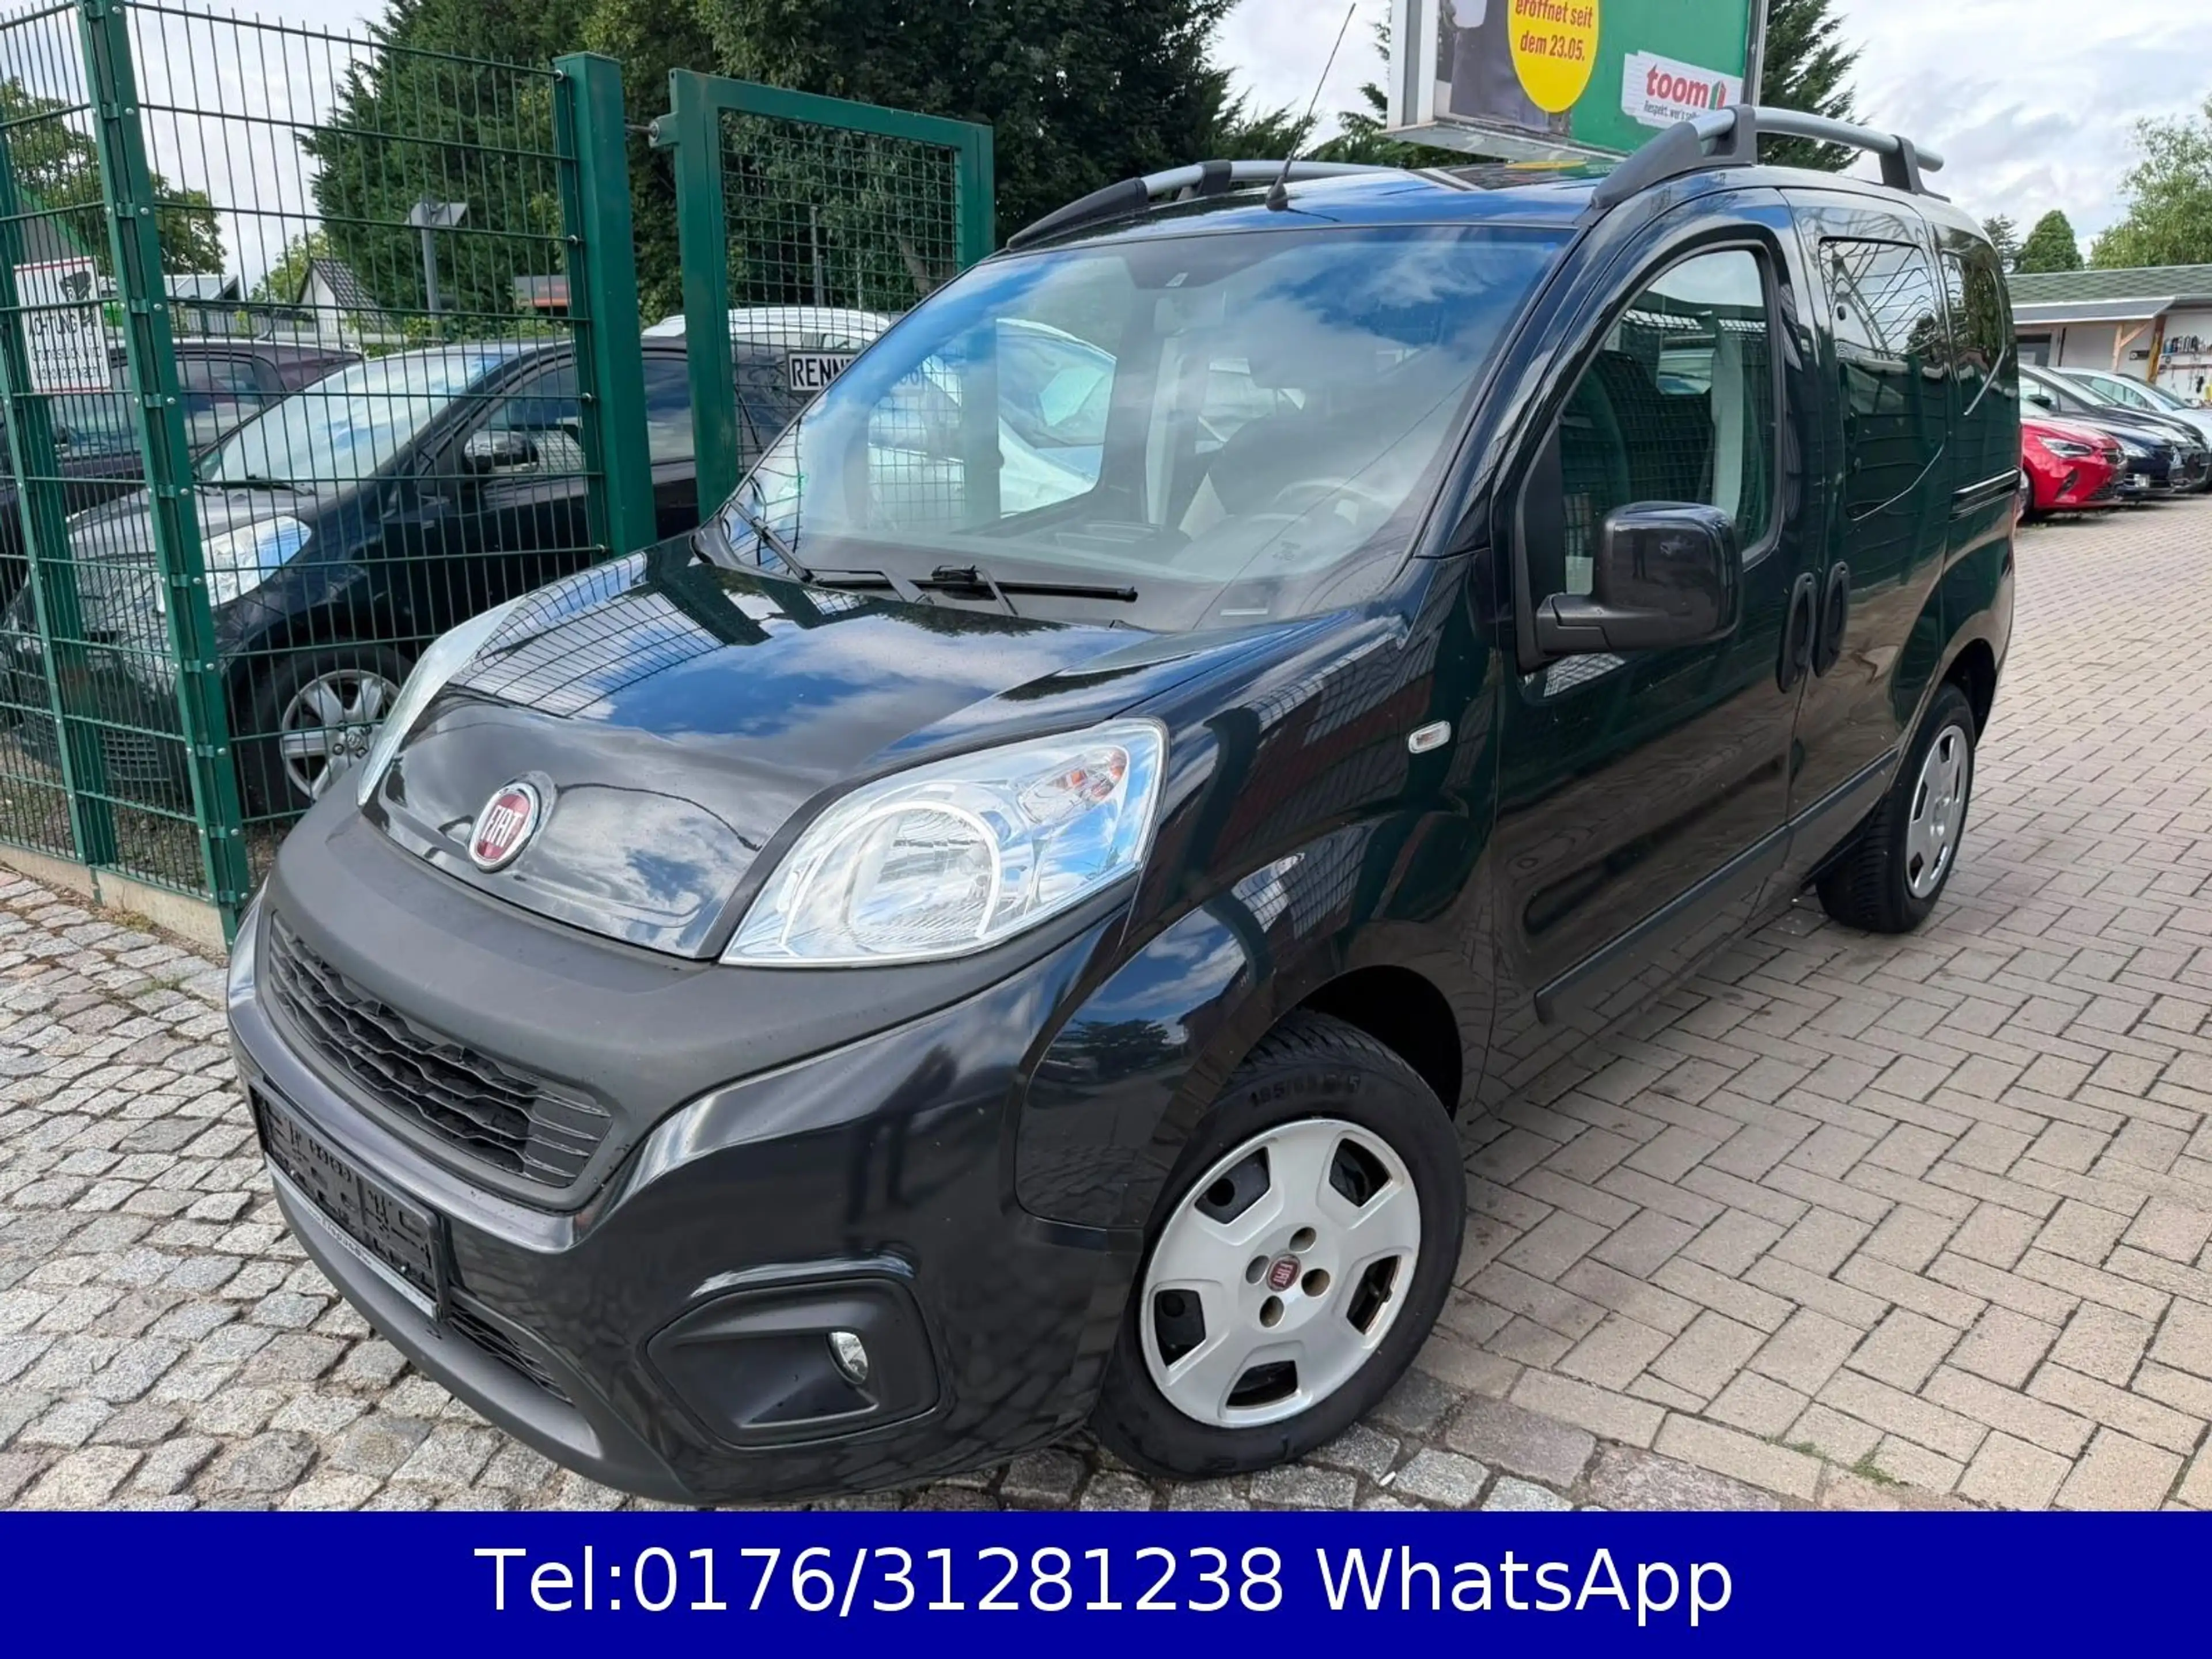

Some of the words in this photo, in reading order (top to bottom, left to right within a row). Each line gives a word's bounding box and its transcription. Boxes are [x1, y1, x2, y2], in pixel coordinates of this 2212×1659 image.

[1570, 7, 1593, 28] seit
[1520, 30, 1547, 56] dem
[1549, 34, 1585, 62] 23.05.
[1646, 64, 1709, 109] toom
[791, 358, 852, 387] RENN
[480, 804, 524, 847] FIAT
[1272, 1263, 1294, 1286] FIAT
